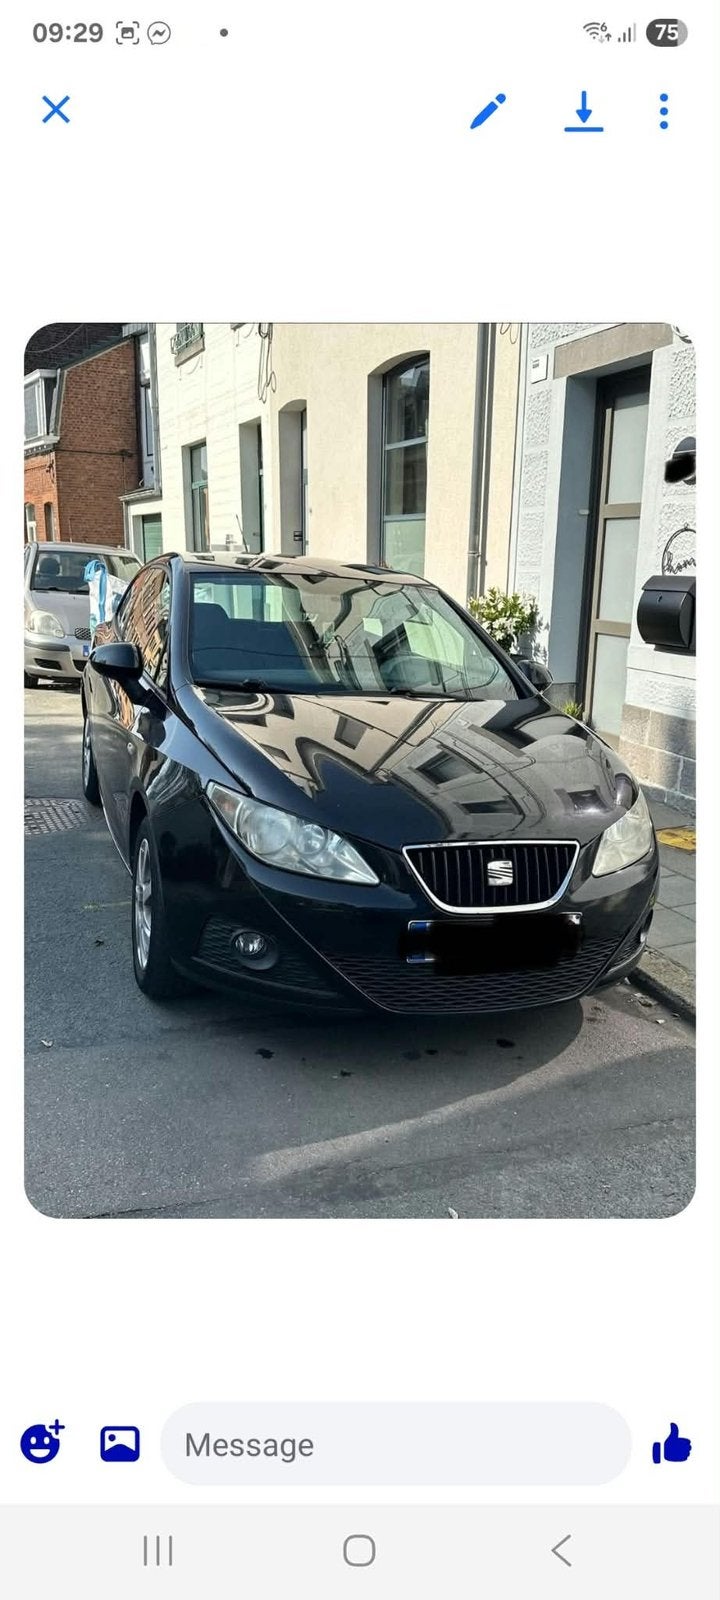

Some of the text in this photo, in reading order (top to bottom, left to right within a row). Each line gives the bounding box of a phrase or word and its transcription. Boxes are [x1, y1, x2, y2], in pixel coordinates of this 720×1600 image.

[33, 22, 104, 43] 09:29
[600, 22, 608, 32] 6
[655, 24, 679, 41] 75
[185, 1432, 314, 1463] Message
